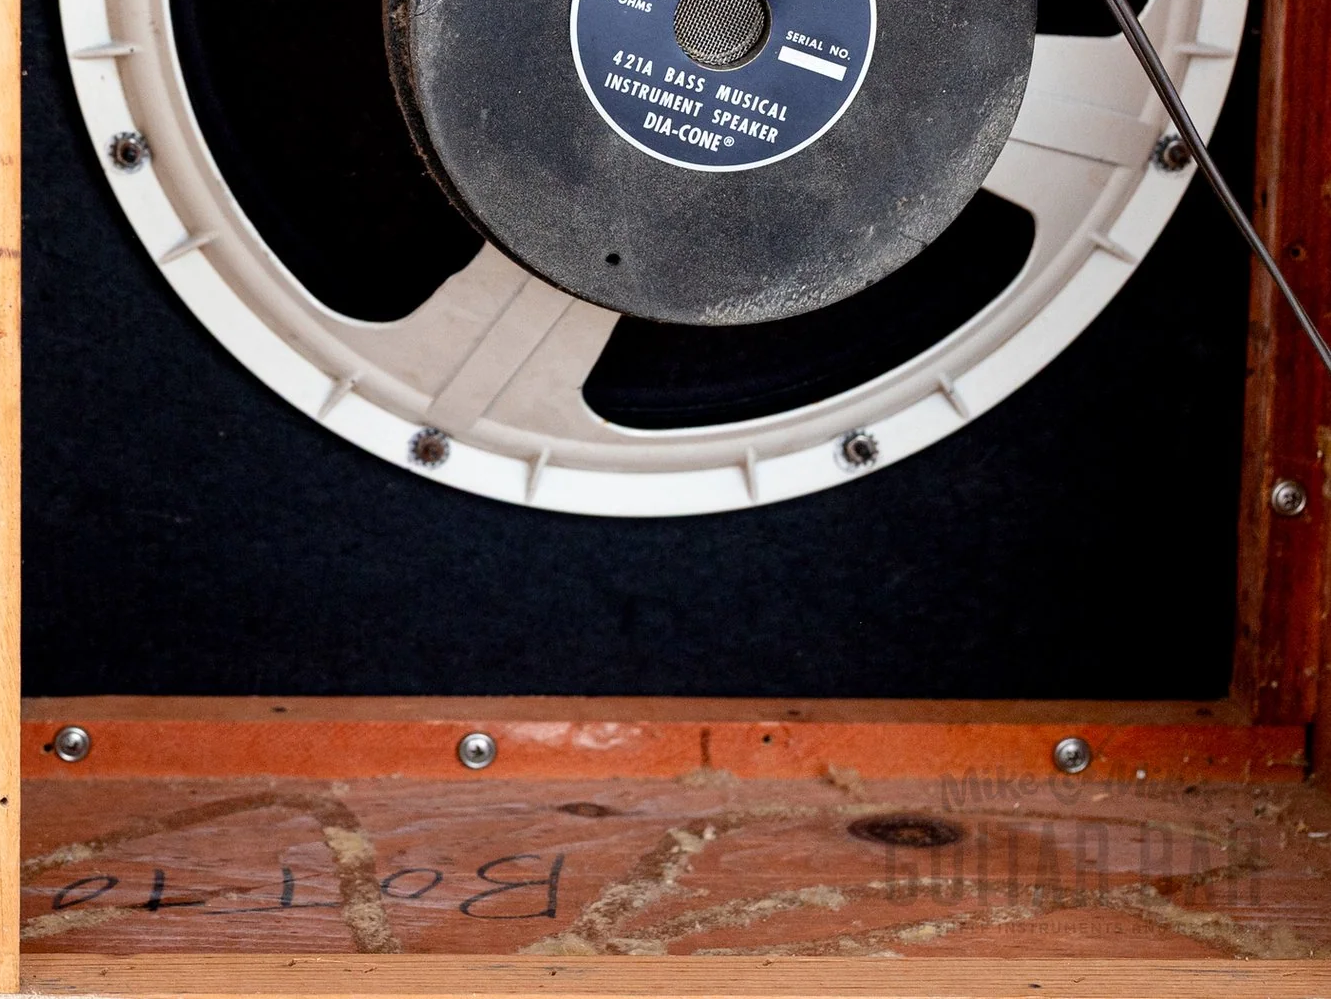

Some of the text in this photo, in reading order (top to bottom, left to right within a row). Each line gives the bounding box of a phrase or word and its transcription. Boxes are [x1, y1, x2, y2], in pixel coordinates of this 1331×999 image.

[786, 30, 851, 60] SERIAL NO.
[604, 73, 778, 144] INSTRUMENT SPEAKER
[613, 51, 787, 122] 421A BASS MUSICAL
